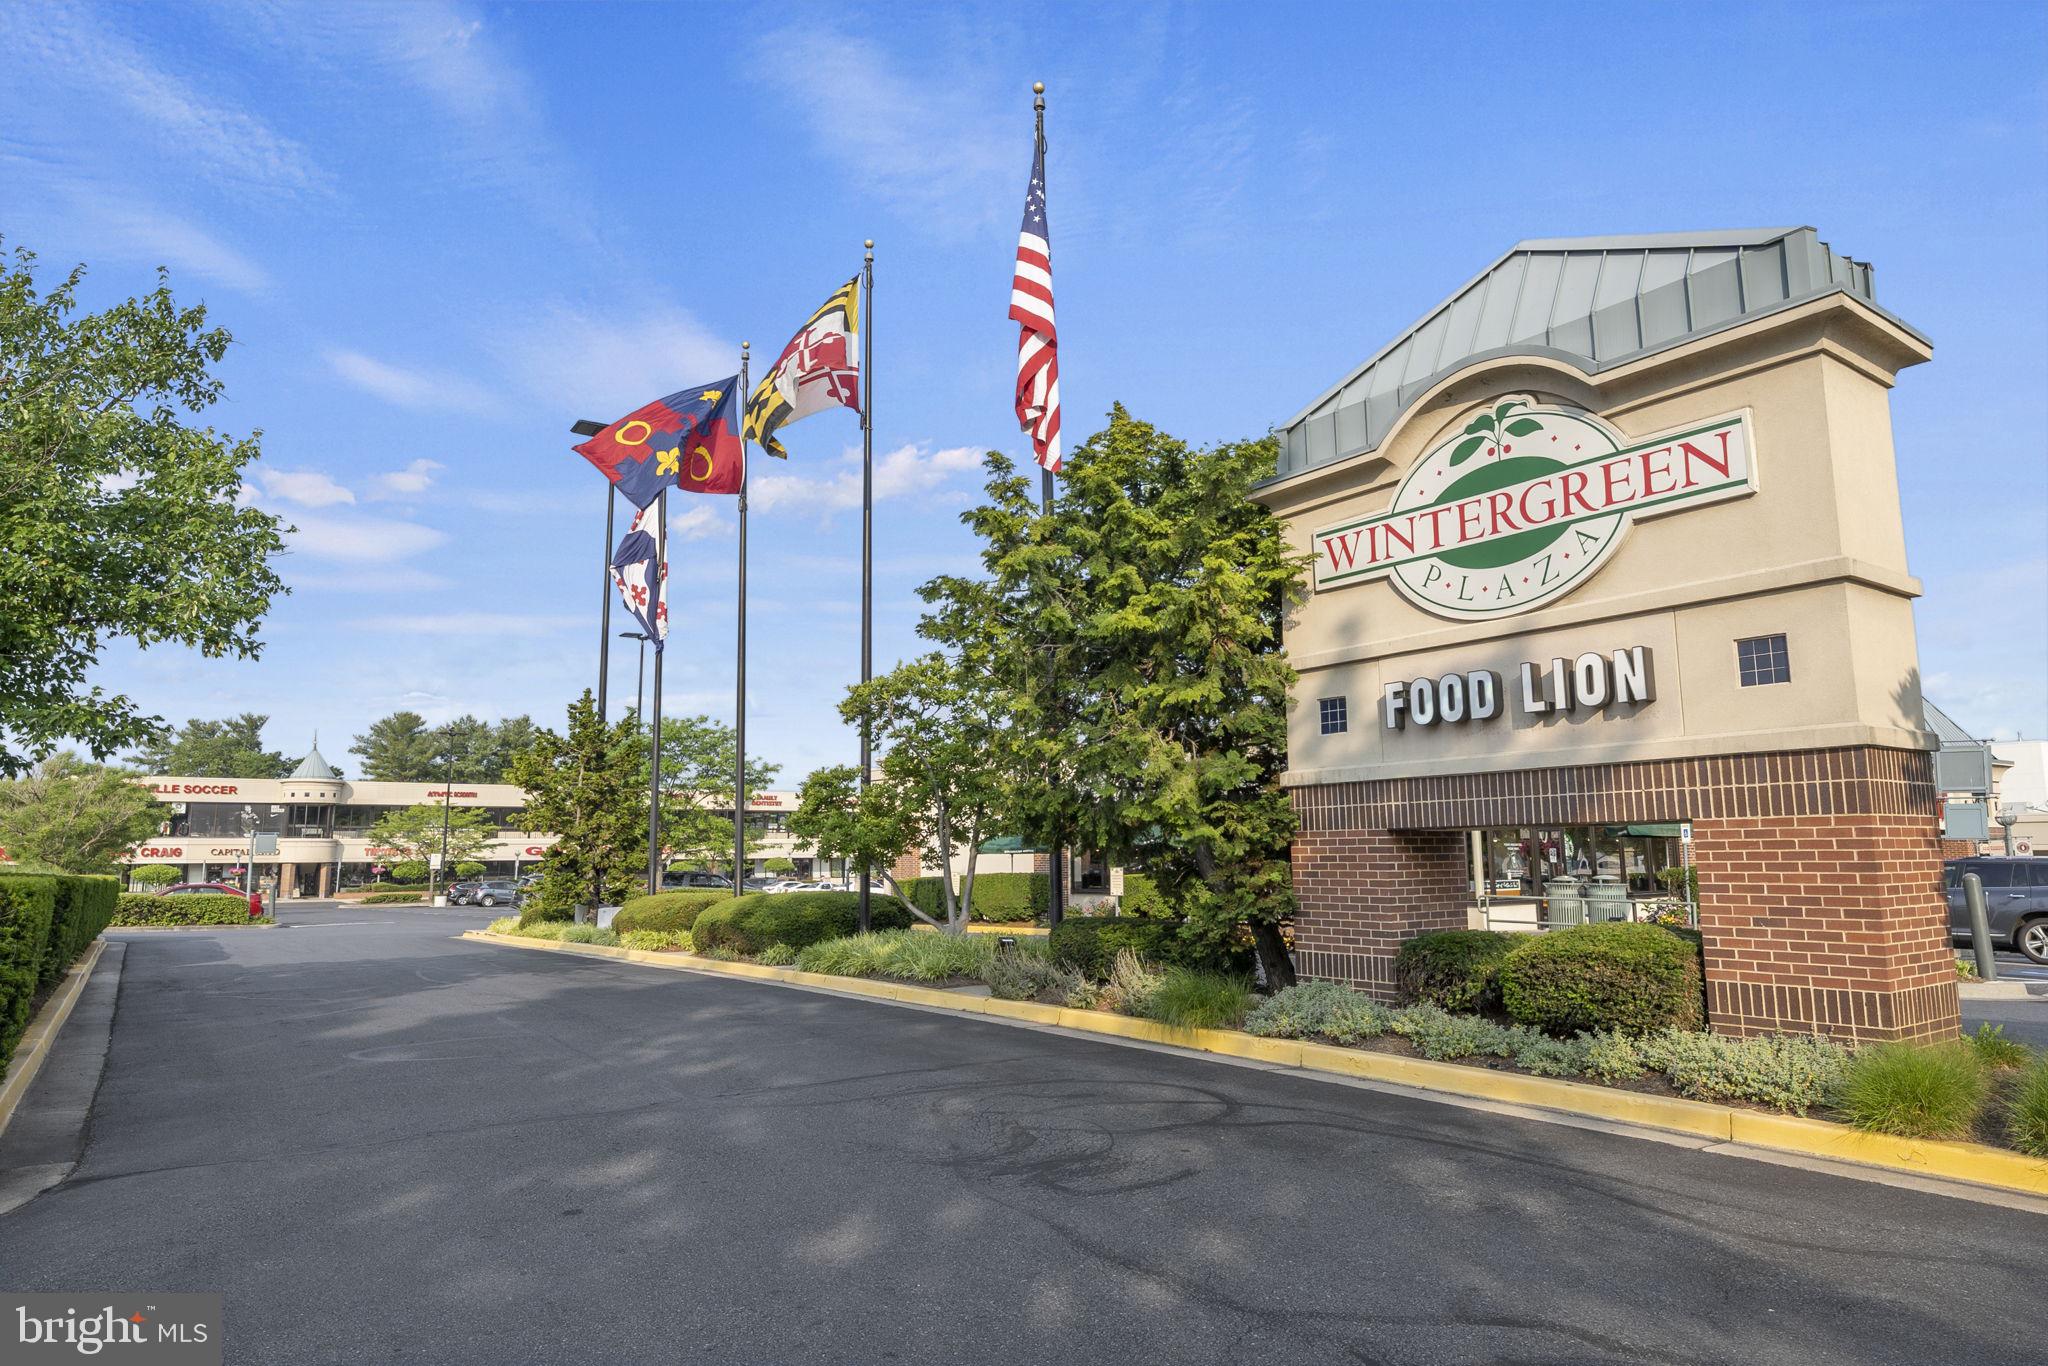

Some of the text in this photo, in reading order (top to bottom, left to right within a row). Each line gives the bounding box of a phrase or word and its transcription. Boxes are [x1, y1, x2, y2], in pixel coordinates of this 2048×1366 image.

[1323, 431, 1732, 574] WINTERGREEN
[1384, 645, 1653, 729] FOOD LION
[183, 785, 238, 795] SOCCER
[140, 847, 183, 858] CRAIG
